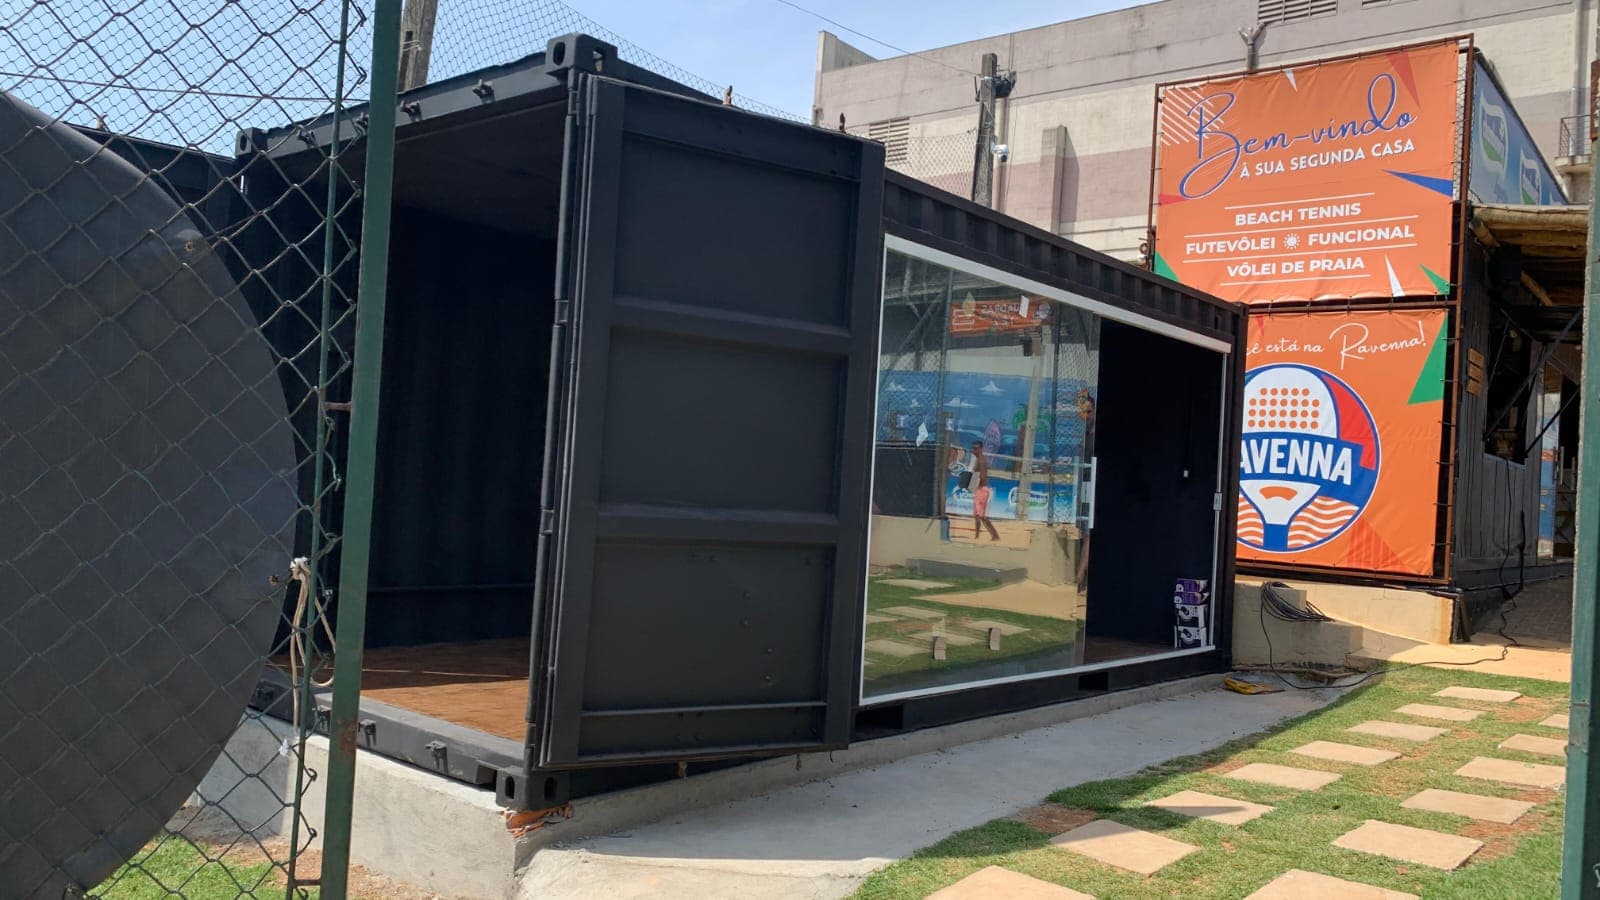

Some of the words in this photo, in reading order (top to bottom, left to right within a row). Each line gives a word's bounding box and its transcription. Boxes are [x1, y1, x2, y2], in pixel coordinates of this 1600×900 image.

[1178, 73, 1417, 199] Bem-vindo
[1255, 159, 1285, 176] SUA
[1290, 147, 1365, 171] SEGUNDA
[1371, 138, 1415, 157] CASA
[1235, 209, 1293, 226] BEACH
[1298, 202, 1361, 221] TENNIS
[1186, 236, 1276, 255] FUTEVÔLEI
[1308, 225, 1415, 246] FUNCIONAL
[1227, 261, 1276, 277] VÔLEI
[1281, 260, 1305, 274] DE
[1309, 256, 1365, 272] PRAIA
[1265, 337, 1299, 353] está
[1303, 343, 1325, 353] na
[1329, 319, 1427, 371] Ravenna!
[1240, 438, 1352, 486] AVENNA
